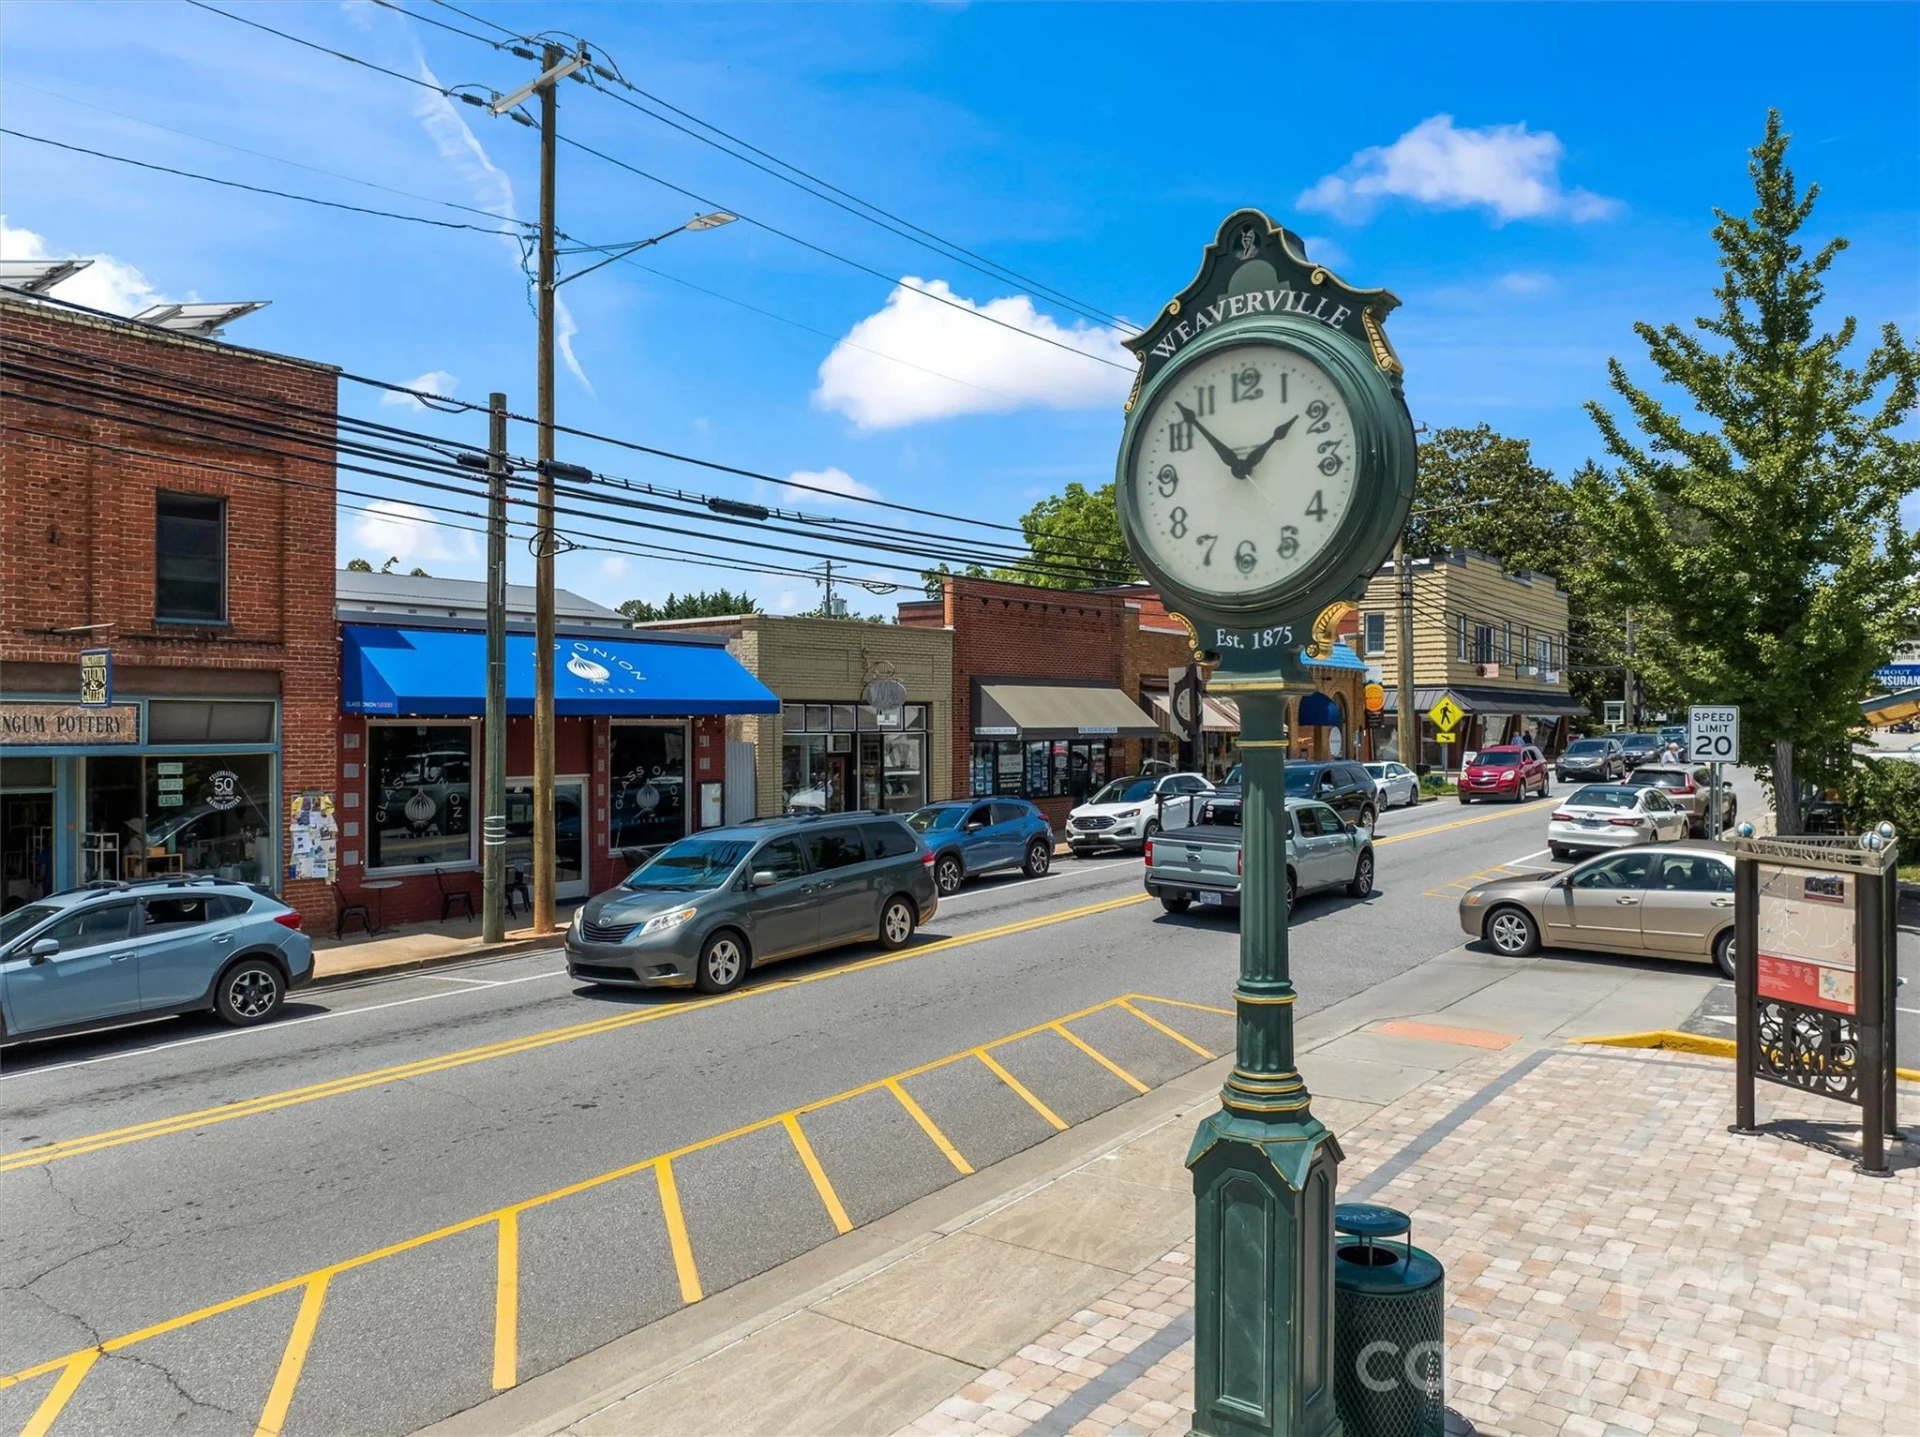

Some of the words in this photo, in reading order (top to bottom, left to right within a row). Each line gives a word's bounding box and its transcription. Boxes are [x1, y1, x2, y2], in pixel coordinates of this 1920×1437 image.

[1150, 290, 1352, 358] WEAVERVILLE
[1198, 385, 1215, 417] 11
[1231, 367, 1264, 403] 12
[1280, 373, 1288, 403] 1
[1305, 400, 1331, 434] 2
[1168, 421, 1194, 452] 10
[1317, 439, 1343, 477] 3
[1157, 464, 1179, 498] 9
[1304, 490, 1328, 522] 4
[1169, 506, 1188, 539] 8
[1196, 534, 1218, 567] 7
[1234, 540, 1258, 574] 6
[1277, 525, 1300, 559] 5
[1216, 628, 1245, 649] Est.
[1252, 626, 1293, 650] 1875
[82, 667, 107, 684] STUDIO
[573, 642, 647, 680] ONION
[90, 681, 99, 690] &
[57, 716, 123, 733] POTTERY
[1694, 712, 1734, 721] SPEED
[1698, 724, 1729, 733] LIMIT
[1695, 735, 1732, 756] 20
[215, 777, 234, 792] 50
[615, 766, 644, 810] GLASS
[1750, 842, 1861, 866] WEAVERVILLE
